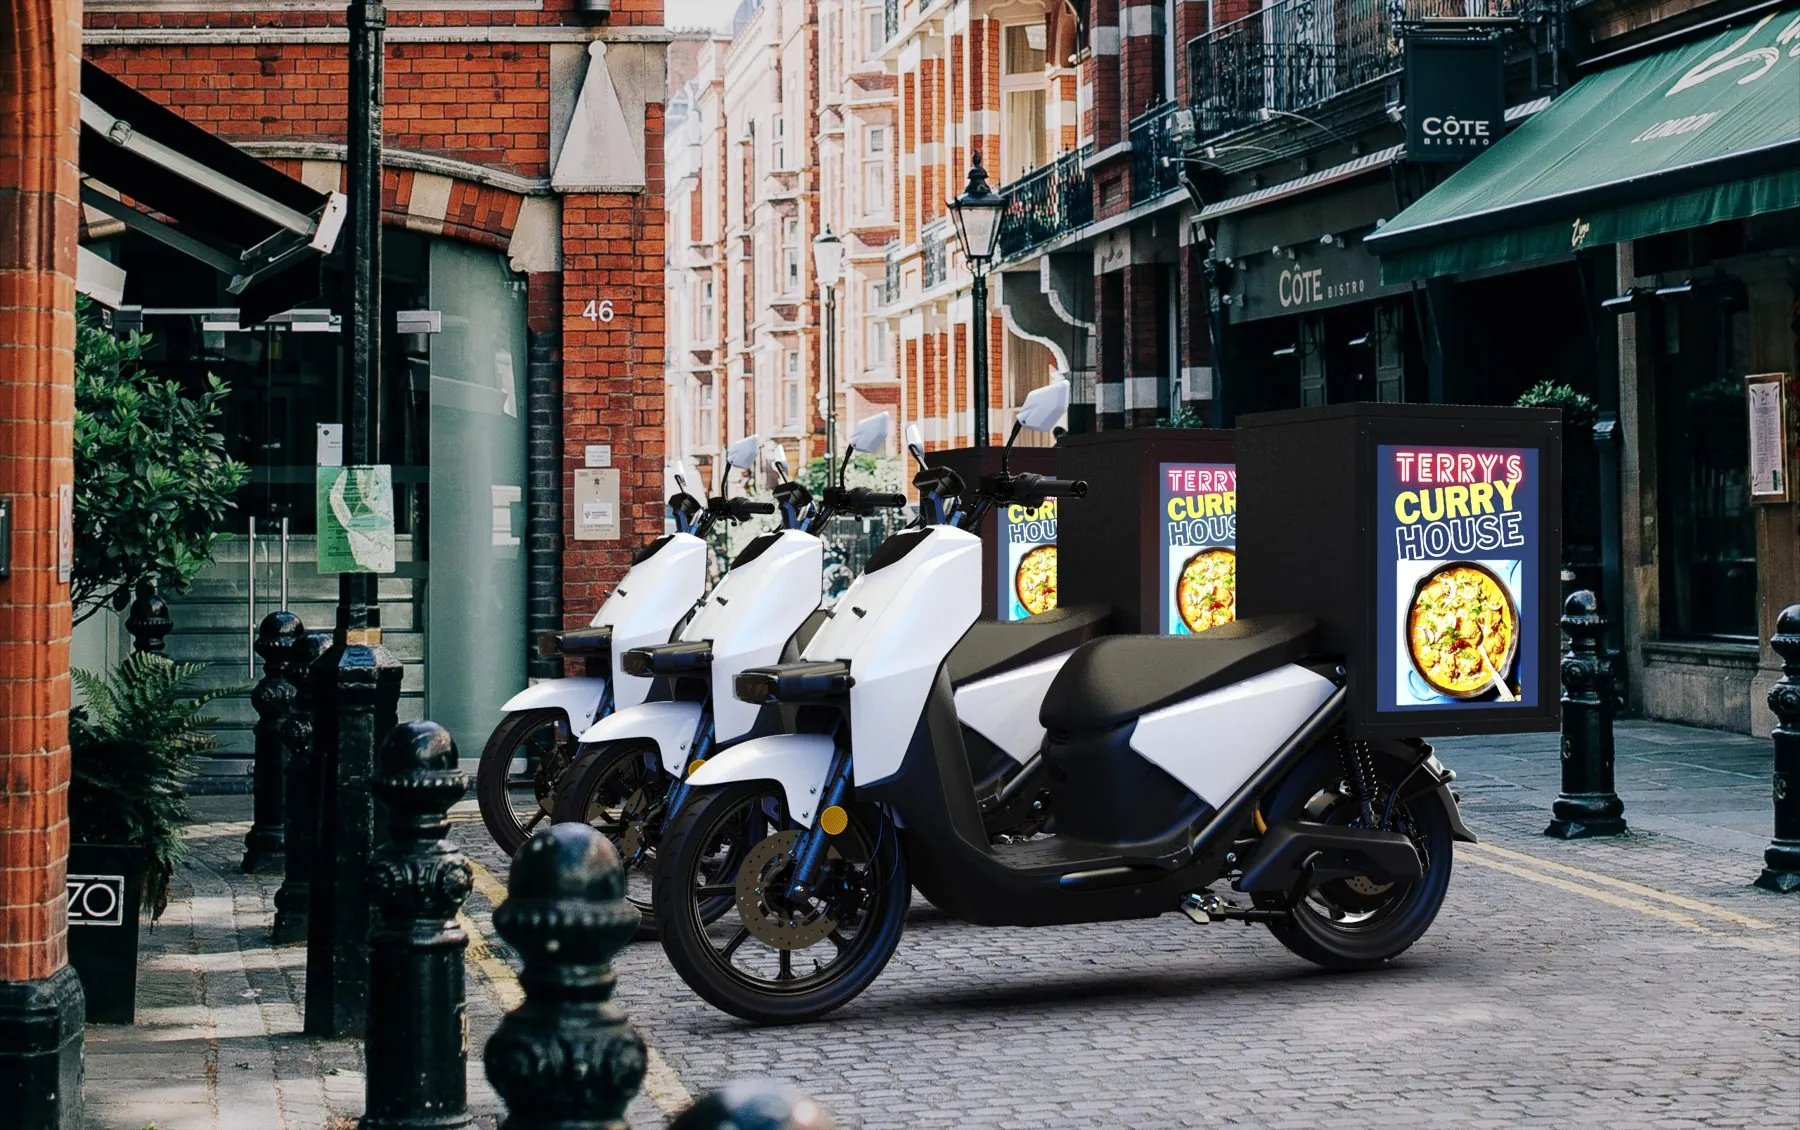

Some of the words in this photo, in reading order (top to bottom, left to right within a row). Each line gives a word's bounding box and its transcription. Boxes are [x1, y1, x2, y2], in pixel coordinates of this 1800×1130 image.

[1422, 115, 1490, 135] CÔTE
[1423, 137, 1490, 146] BISTRO
[1630, 109, 1722, 144] LONDON
[1279, 263, 1323, 307] CÔTE
[1327, 279, 1365, 299] BISTRO
[582, 299, 614, 322] 46
[1396, 452, 1523, 484] TERRY'S
[1007, 500, 1058, 524] CUR
[1394, 480, 1517, 525] CURRY
[1395, 510, 1525, 561] HOUSE
[66, 882, 116, 918] ZO
